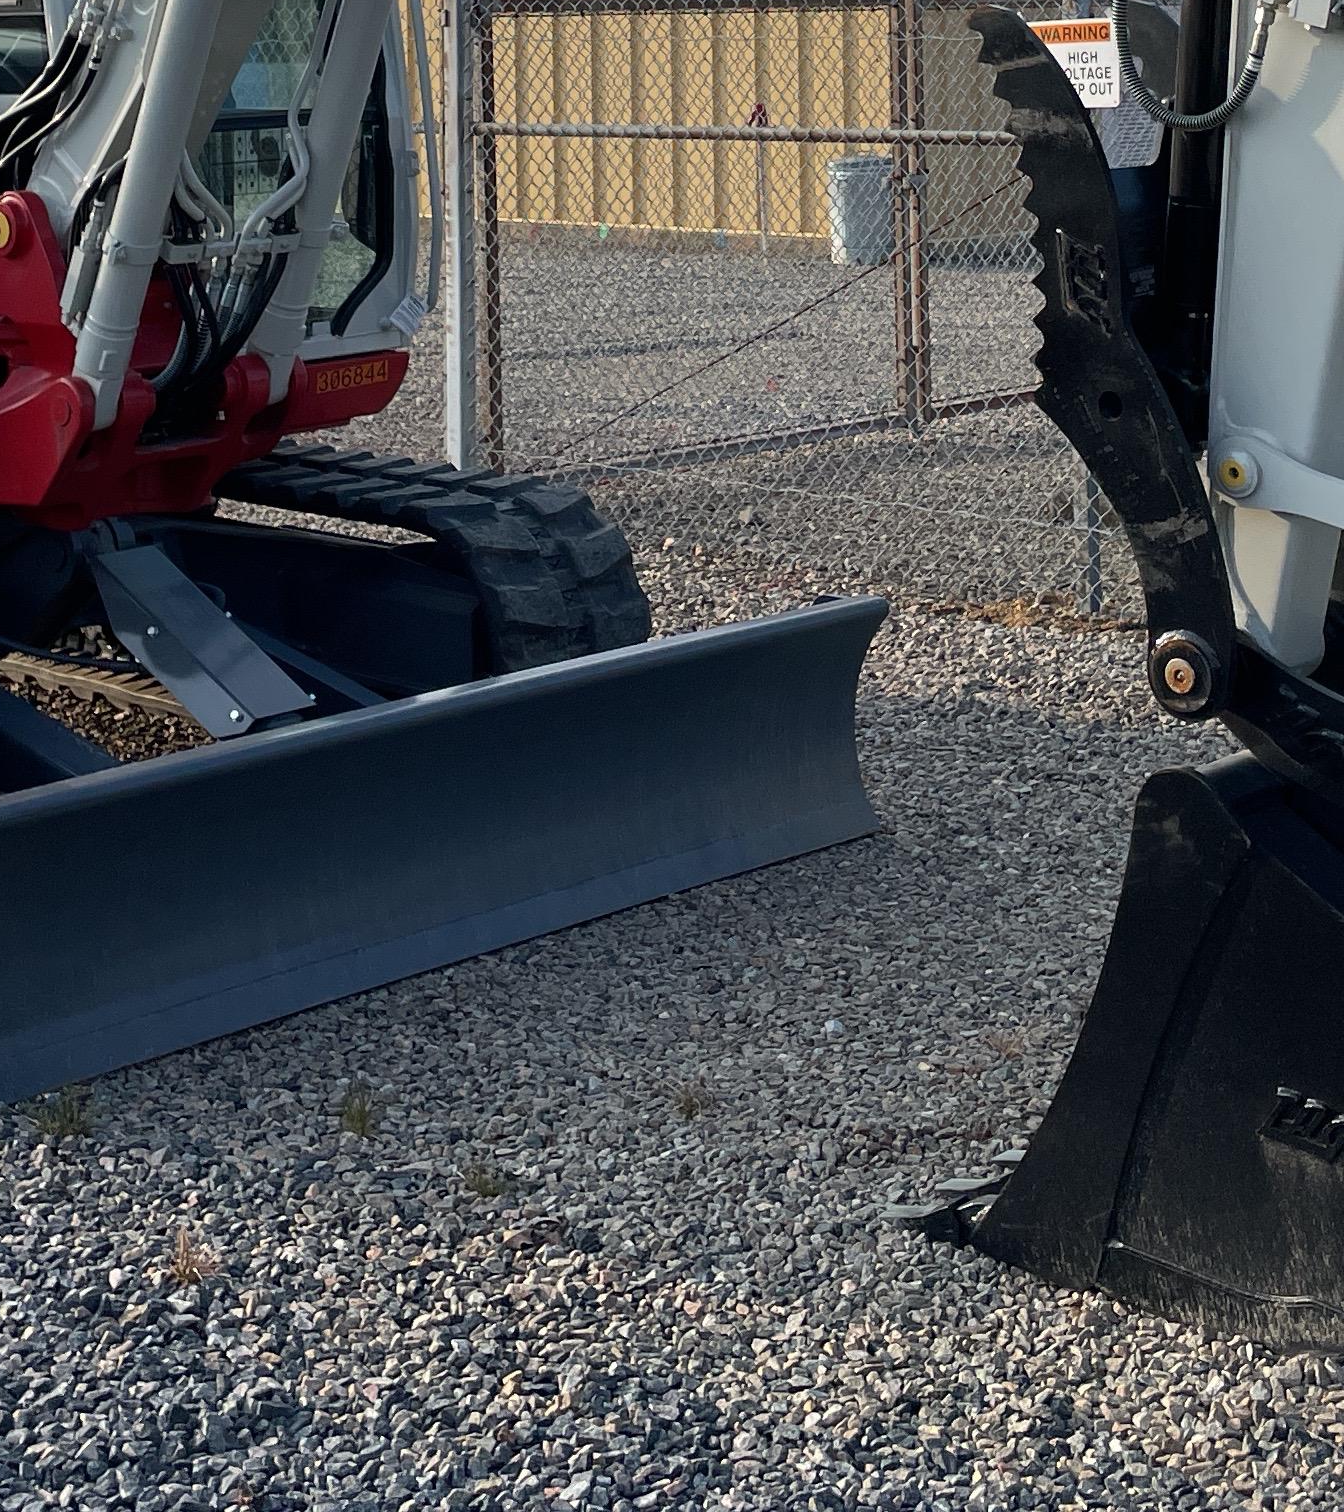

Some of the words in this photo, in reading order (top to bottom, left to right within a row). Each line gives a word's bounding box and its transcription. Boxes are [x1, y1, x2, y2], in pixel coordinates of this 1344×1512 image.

[1040, 25, 1109, 42] WARNING
[1068, 51, 1098, 64] HIGH
[1064, 66, 1112, 80] OLTAGE
[1089, 83, 1113, 95] OUT
[318, 360, 387, 392] 306844
